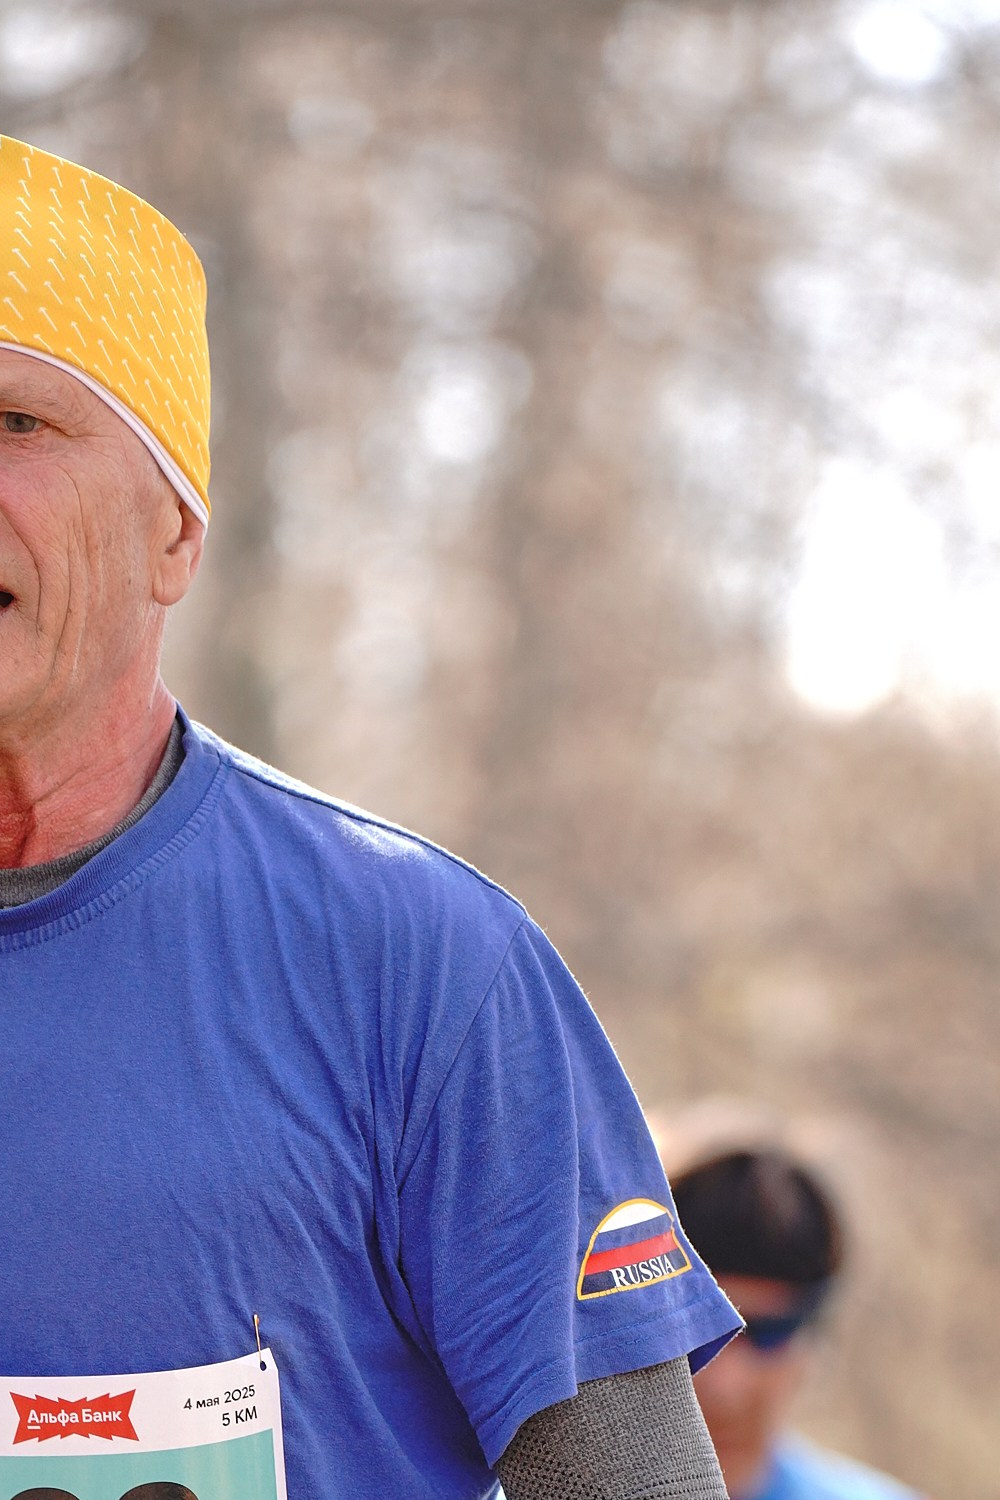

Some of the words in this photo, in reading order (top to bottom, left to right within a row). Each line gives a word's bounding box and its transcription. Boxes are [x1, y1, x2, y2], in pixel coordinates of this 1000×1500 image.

[609, 1254, 675, 1288] RUSSIA
[183, 1397, 192, 1410] 4
[196, 1397, 220, 1409] мая
[224, 1384, 256, 1404] 2025
[27, 1409, 79, 1428] Альфа
[81, 1408, 122, 1423] Банк
[222, 1412, 231, 1427] 5
